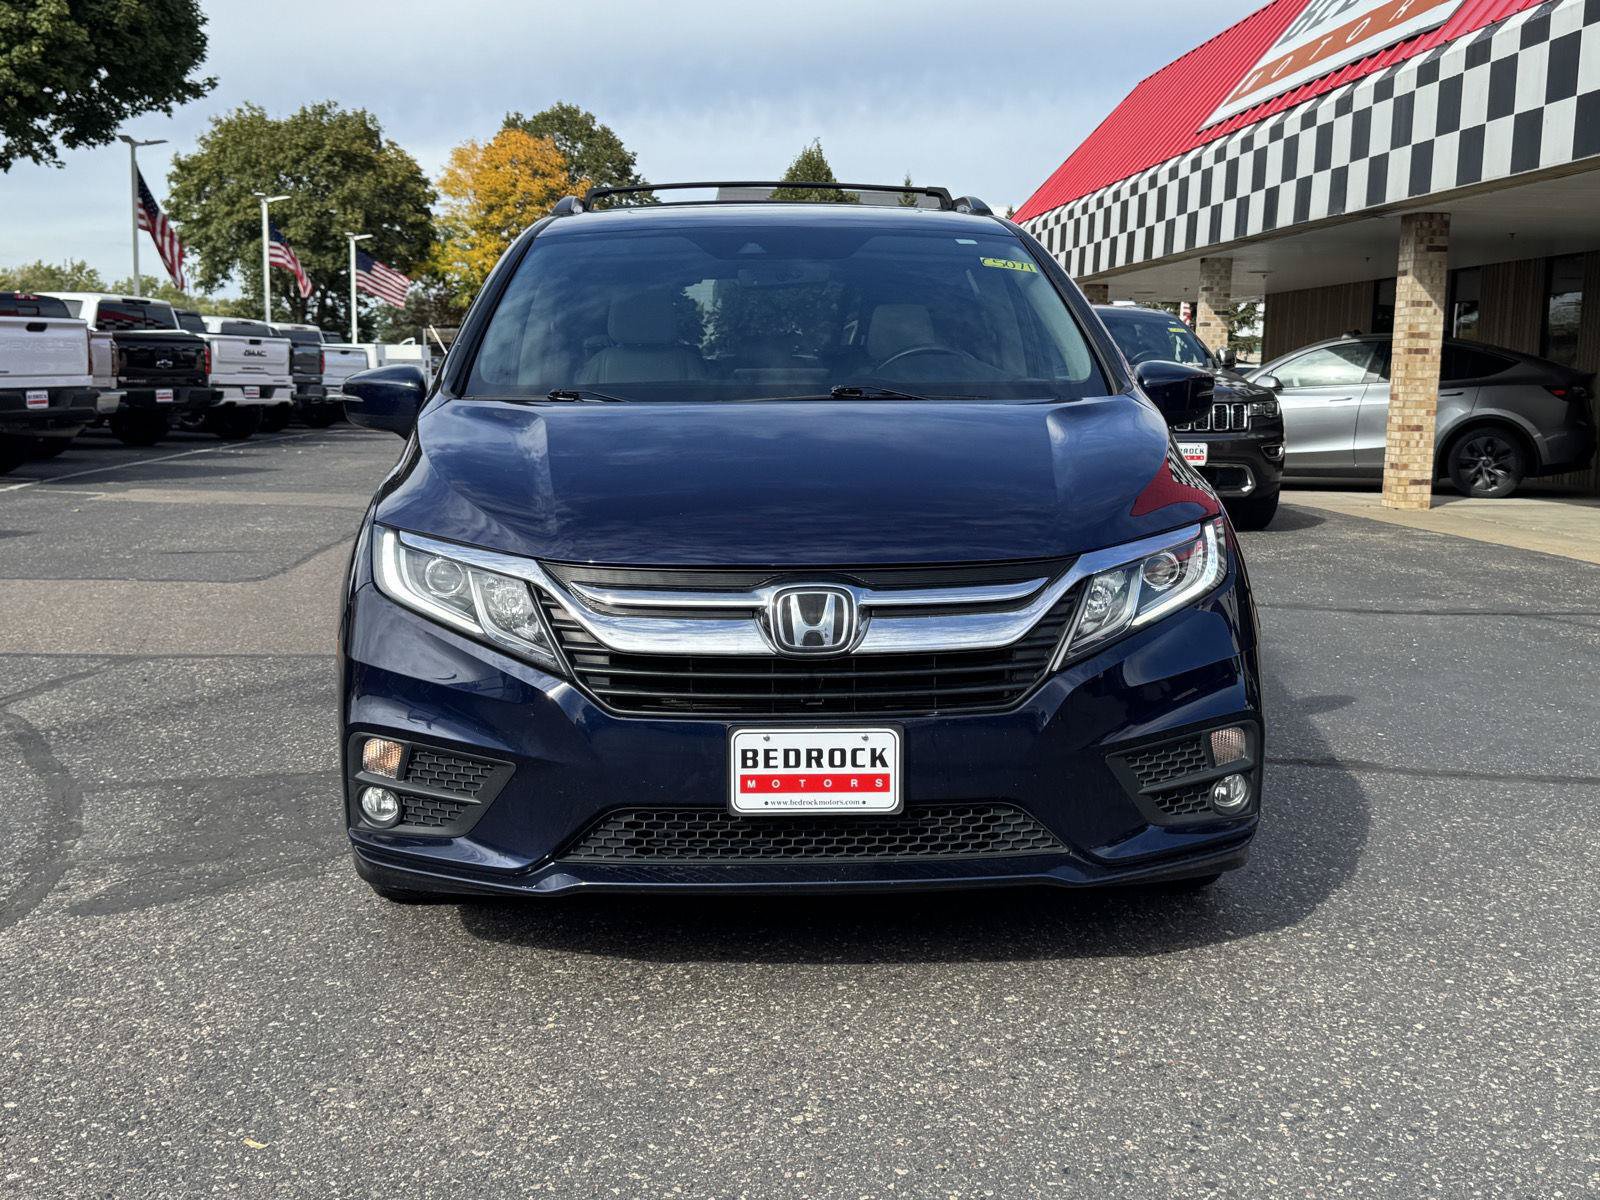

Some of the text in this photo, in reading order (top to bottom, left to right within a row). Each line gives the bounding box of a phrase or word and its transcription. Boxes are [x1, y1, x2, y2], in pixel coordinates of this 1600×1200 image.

[1179, 447, 1204, 455] ROCK
[740, 747, 889, 769] BEDROCK
[746, 778, 883, 789] MOTORS
[769, 799, 860, 807] www.bedrockmotors.com
